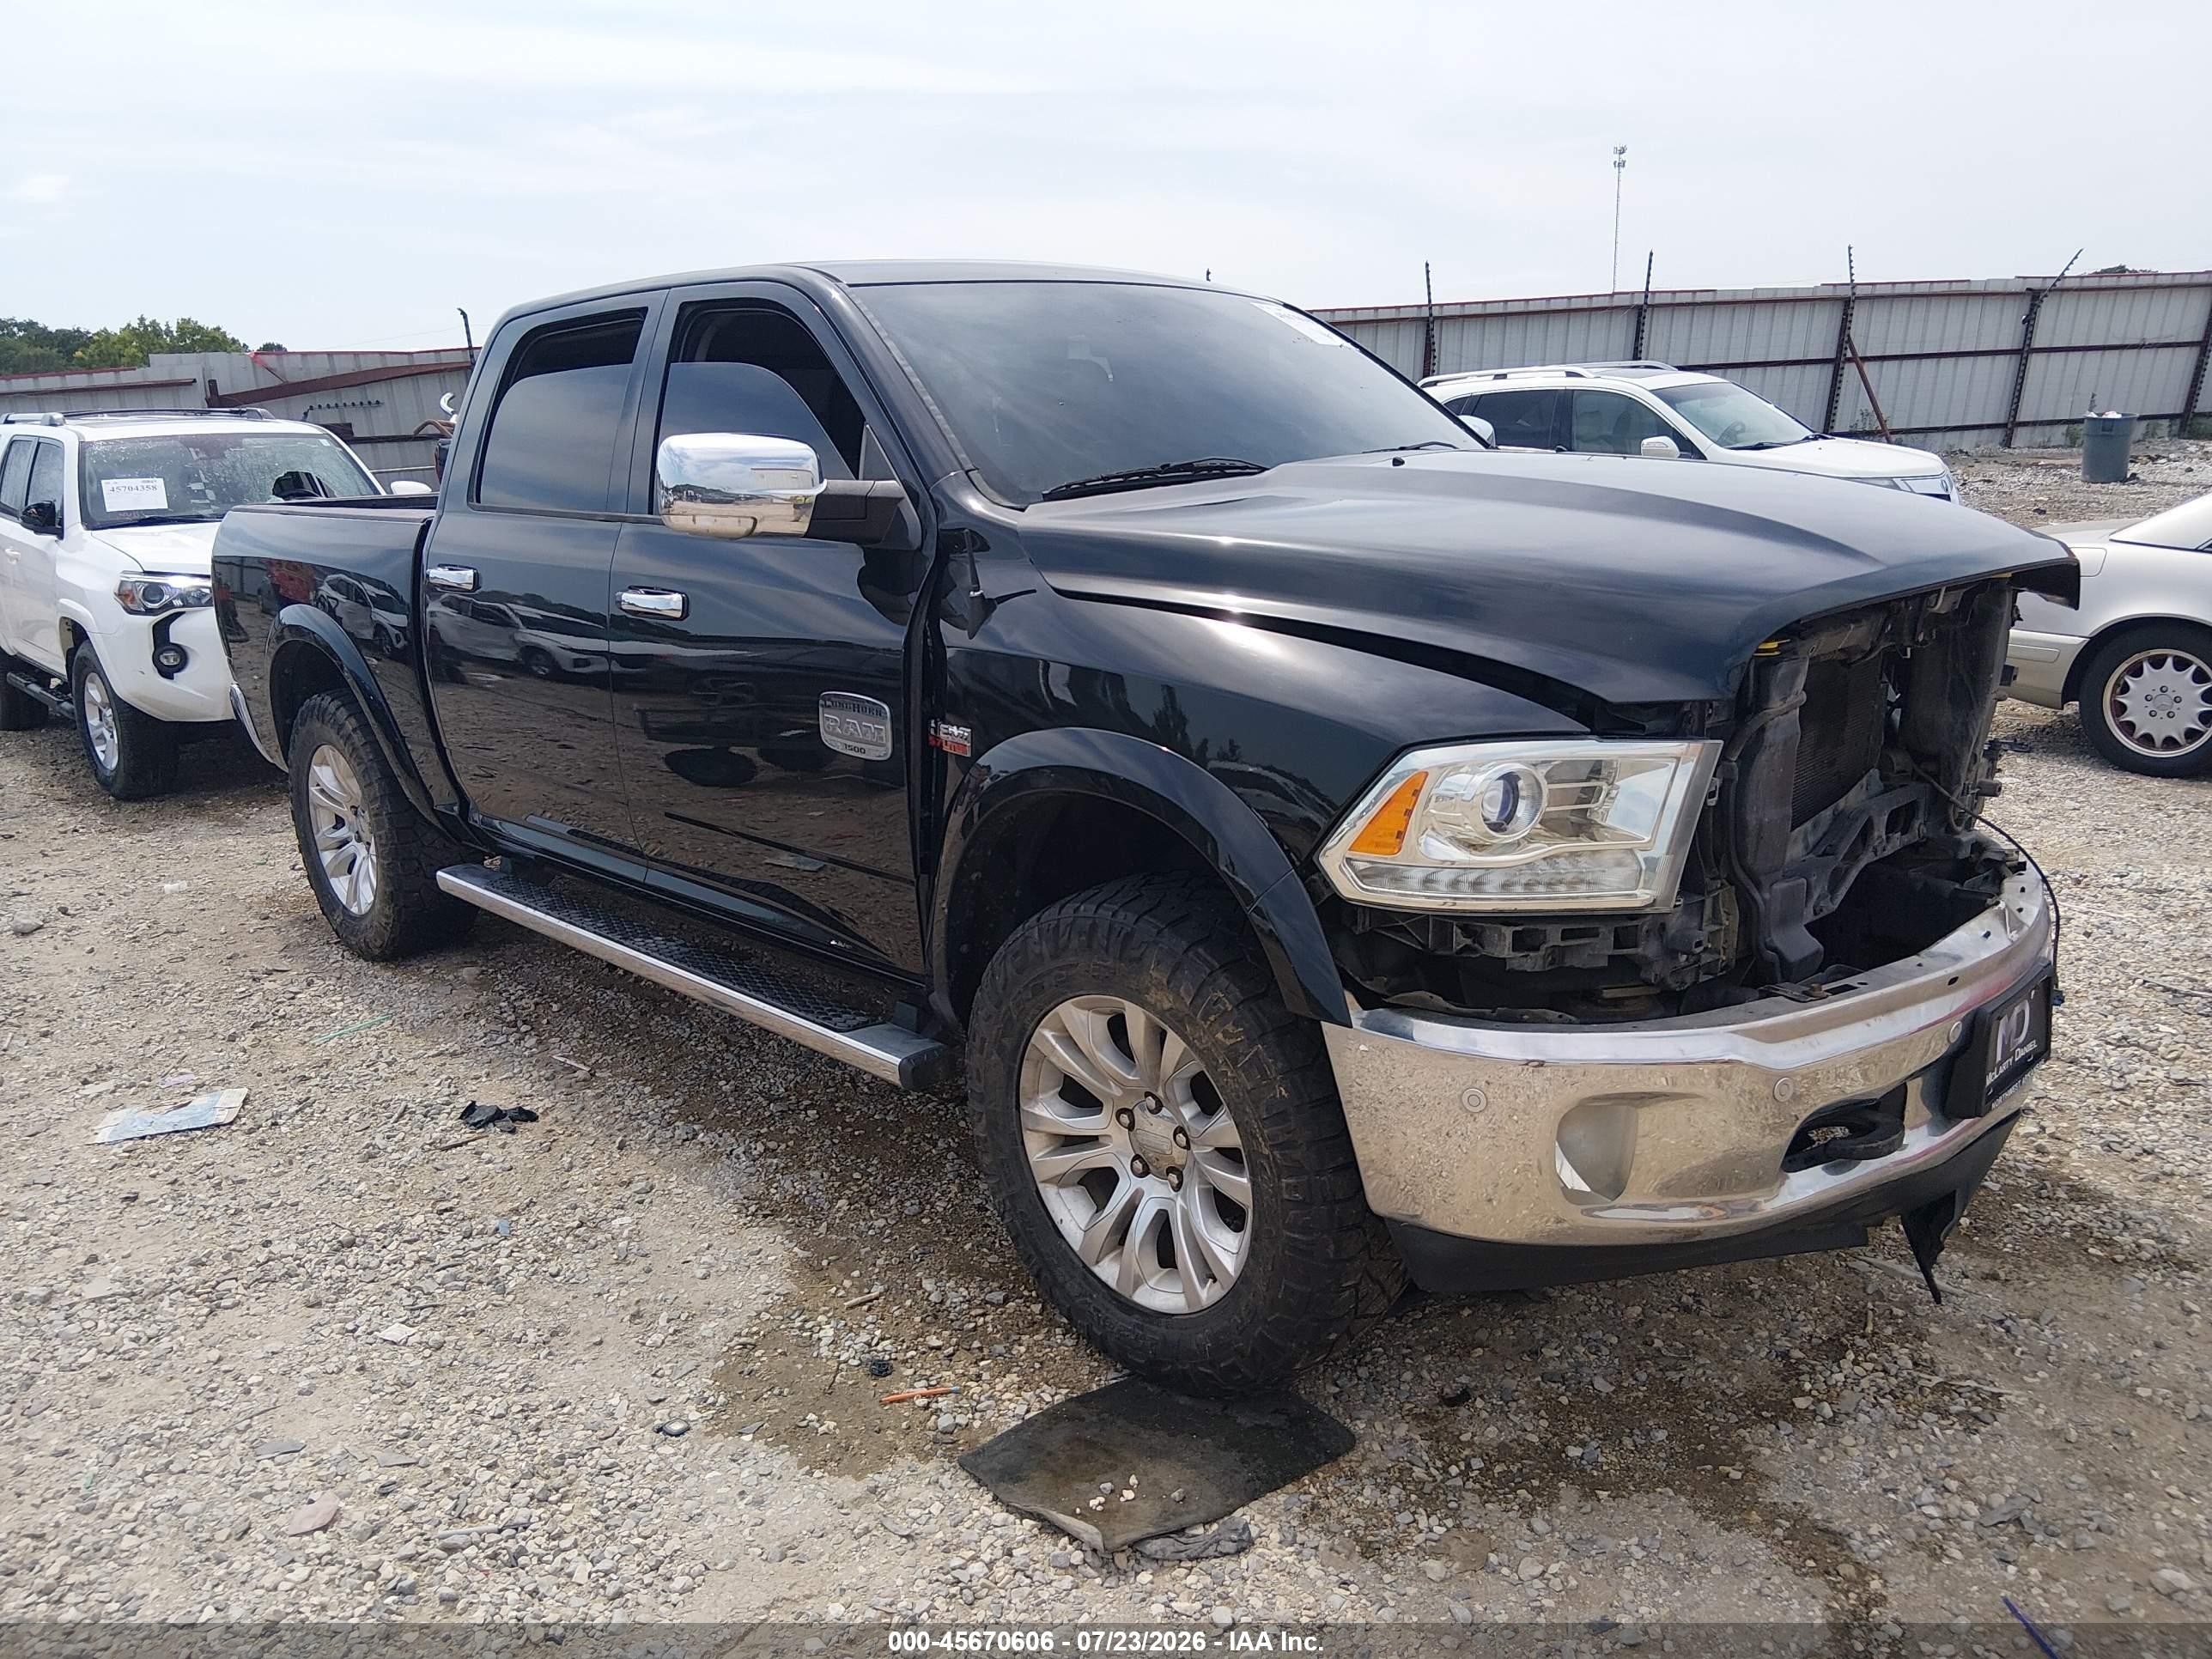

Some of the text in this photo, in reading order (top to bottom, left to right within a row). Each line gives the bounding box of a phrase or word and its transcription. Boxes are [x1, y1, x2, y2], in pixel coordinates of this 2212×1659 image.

[109, 484, 158, 493] 45704358
[823, 714, 886, 743] RAM
[844, 743, 866, 755] 1500
